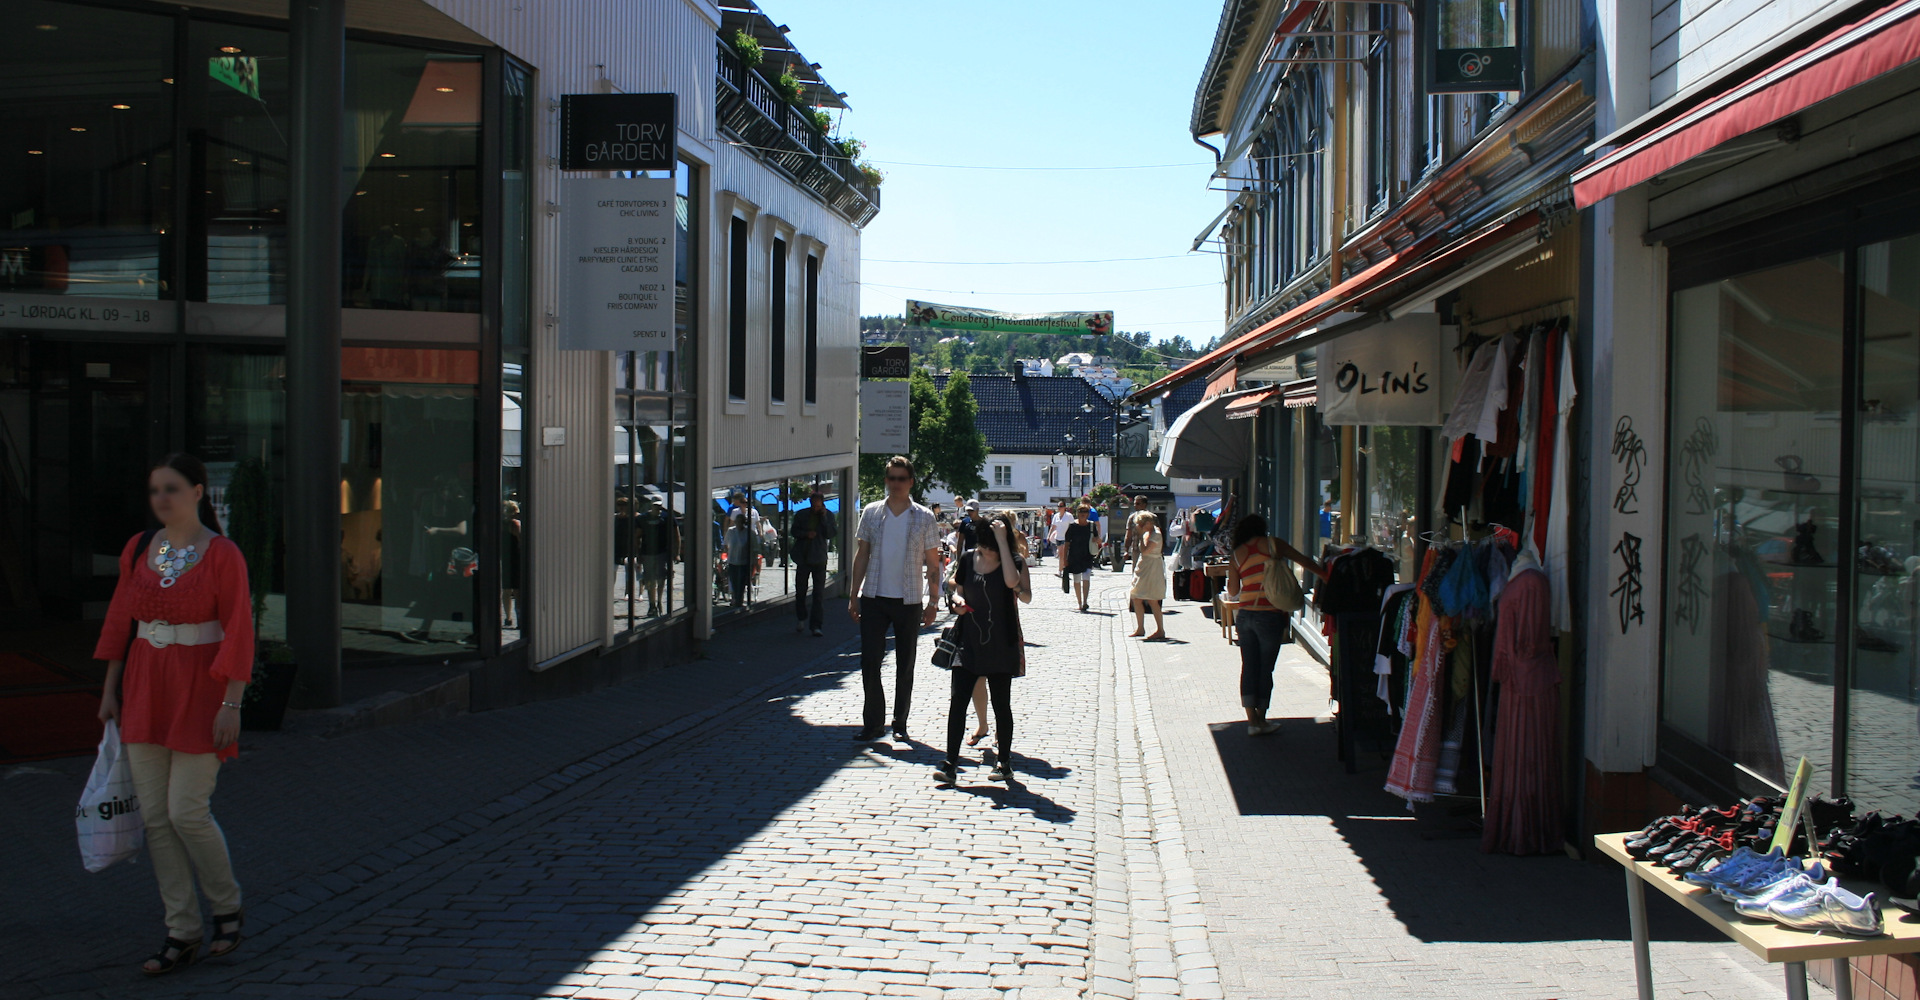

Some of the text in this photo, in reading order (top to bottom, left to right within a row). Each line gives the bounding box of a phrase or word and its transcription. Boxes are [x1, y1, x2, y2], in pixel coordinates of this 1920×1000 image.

[616, 123, 666, 142] TORV
[585, 140, 666, 162] GÅRDEN
[597, 199, 667, 208] CAFÉ TORVTOPPEN 3
[619, 209, 660, 217] CHIC LIVING
[661, 237, 667, 245] 2
[593, 246, 659, 254] KIESLER HÅRDESIGN
[578, 256, 659, 264] PARFYMERI CLINIC ETHIC
[621, 265, 659, 273] CACAO SKO
[618, 293, 655, 301] BOUTIQUE
[607, 302, 658, 310] FRIIS COMPANY
[21, 304, 76, 321] LØRDAG
[80, 307, 99, 321] KL.
[103, 308, 119, 321] 09
[135, 309, 150, 323] 18
[632, 330, 667, 338] SPENST U
[885, 358, 907, 367] TORV
[871, 365, 907, 375] GÅRDEN
[1335, 361, 1429, 394] OLIN'S
